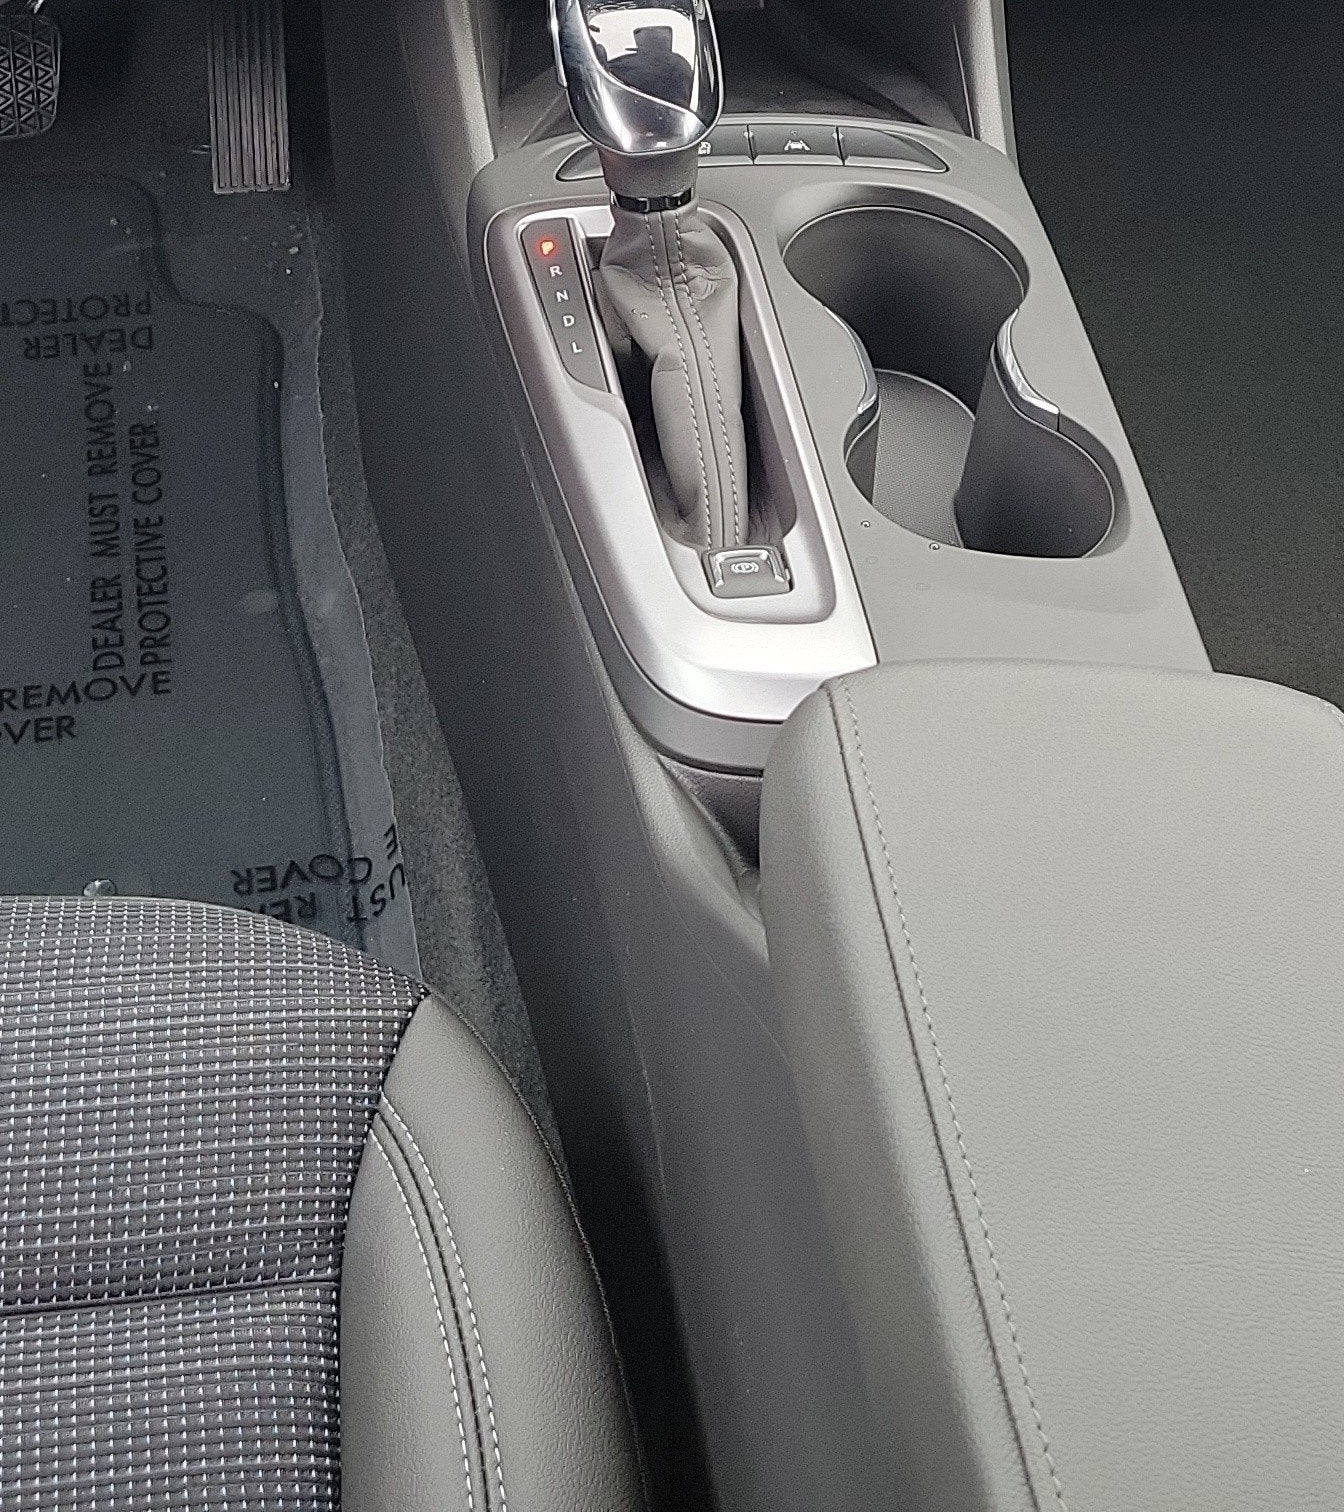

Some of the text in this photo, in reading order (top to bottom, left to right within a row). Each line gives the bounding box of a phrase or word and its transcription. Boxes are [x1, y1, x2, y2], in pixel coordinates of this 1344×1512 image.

[549, 265, 563, 277] R
[556, 289, 569, 303] N
[562, 314, 575, 327] D
[23, 326, 154, 360] DEALER
[571, 341, 583, 354] L
[82, 360, 126, 669] DEALER MUST REMOVE
[128, 421, 174, 667] PROTECTIVE COVER
[229, 853, 373, 896] COVER
